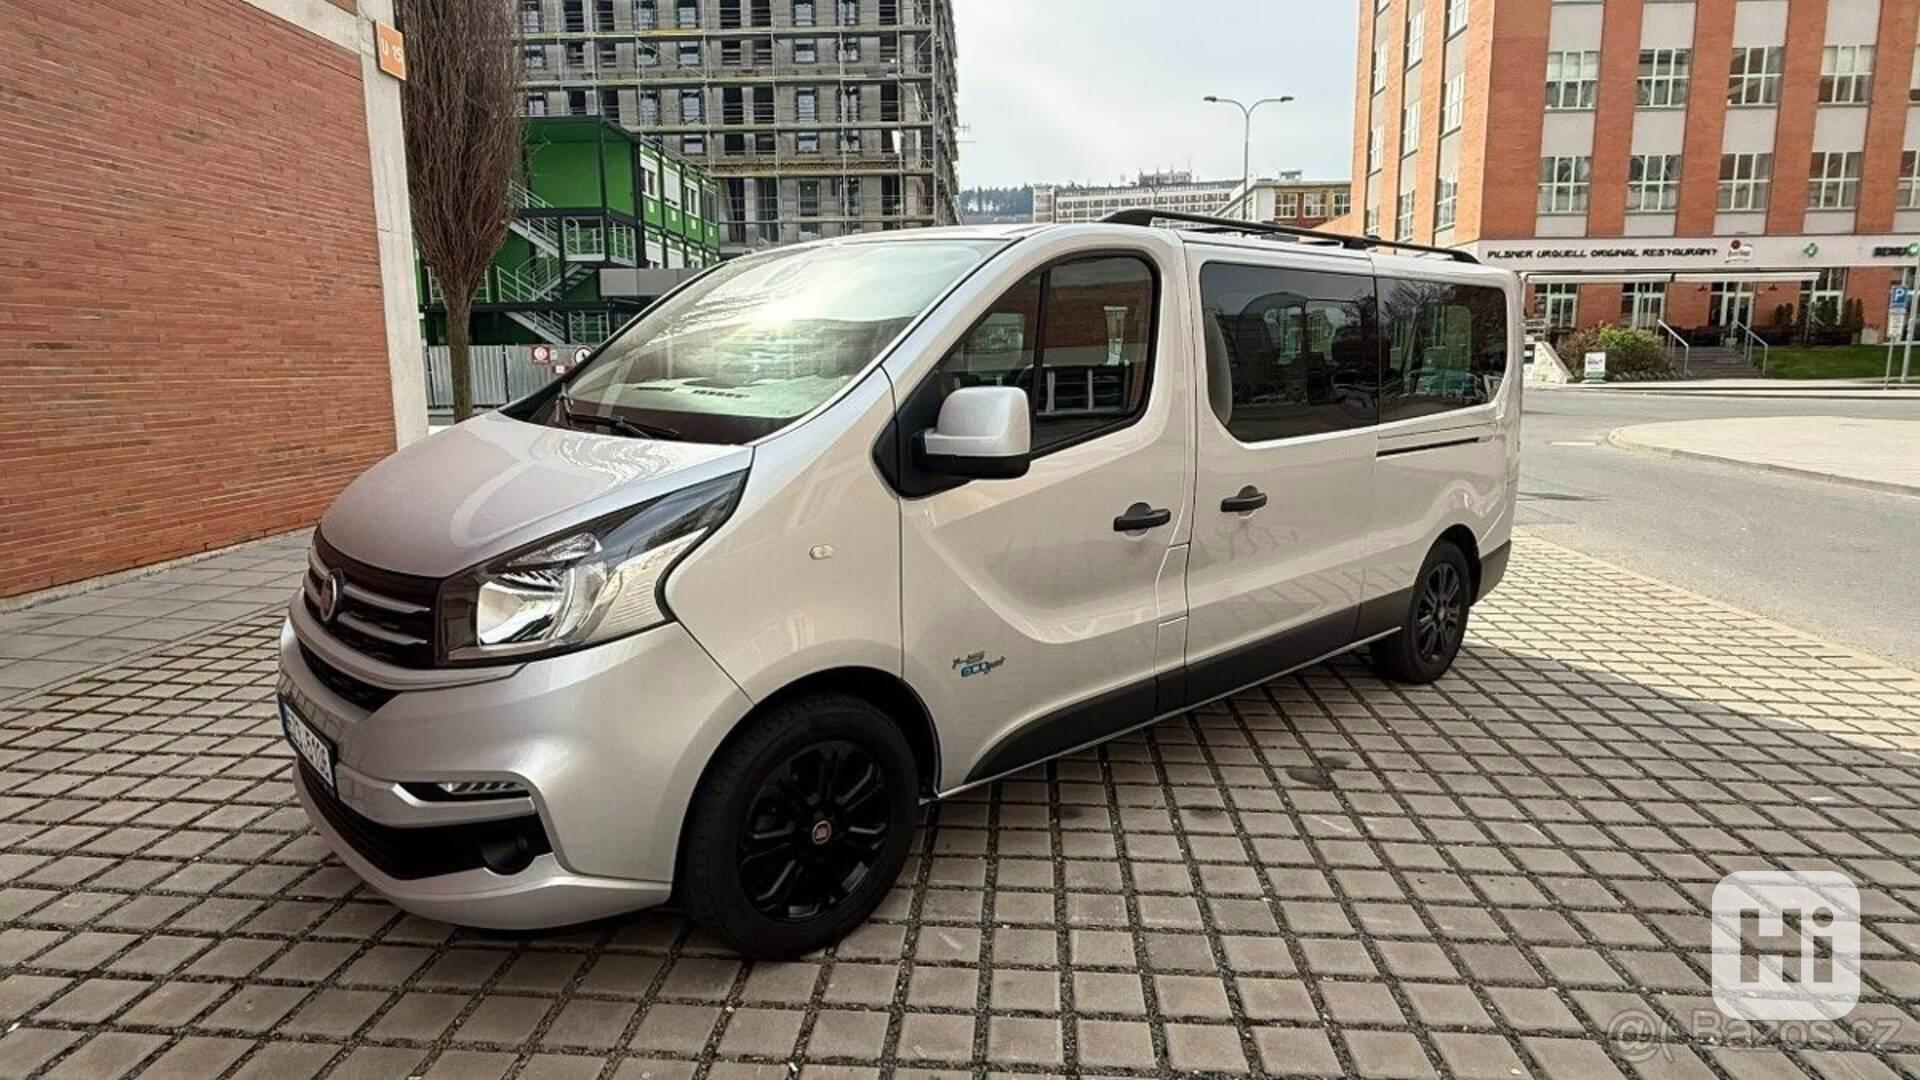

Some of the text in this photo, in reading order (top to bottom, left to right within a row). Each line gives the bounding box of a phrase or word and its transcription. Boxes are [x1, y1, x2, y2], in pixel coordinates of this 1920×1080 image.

[1487, 249, 1533, 259] PILSNER
[1536, 248, 1587, 258] URQUELL
[1590, 248, 1639, 257] ORIGINAL
[1641, 247, 1718, 257] RESTAURANT
